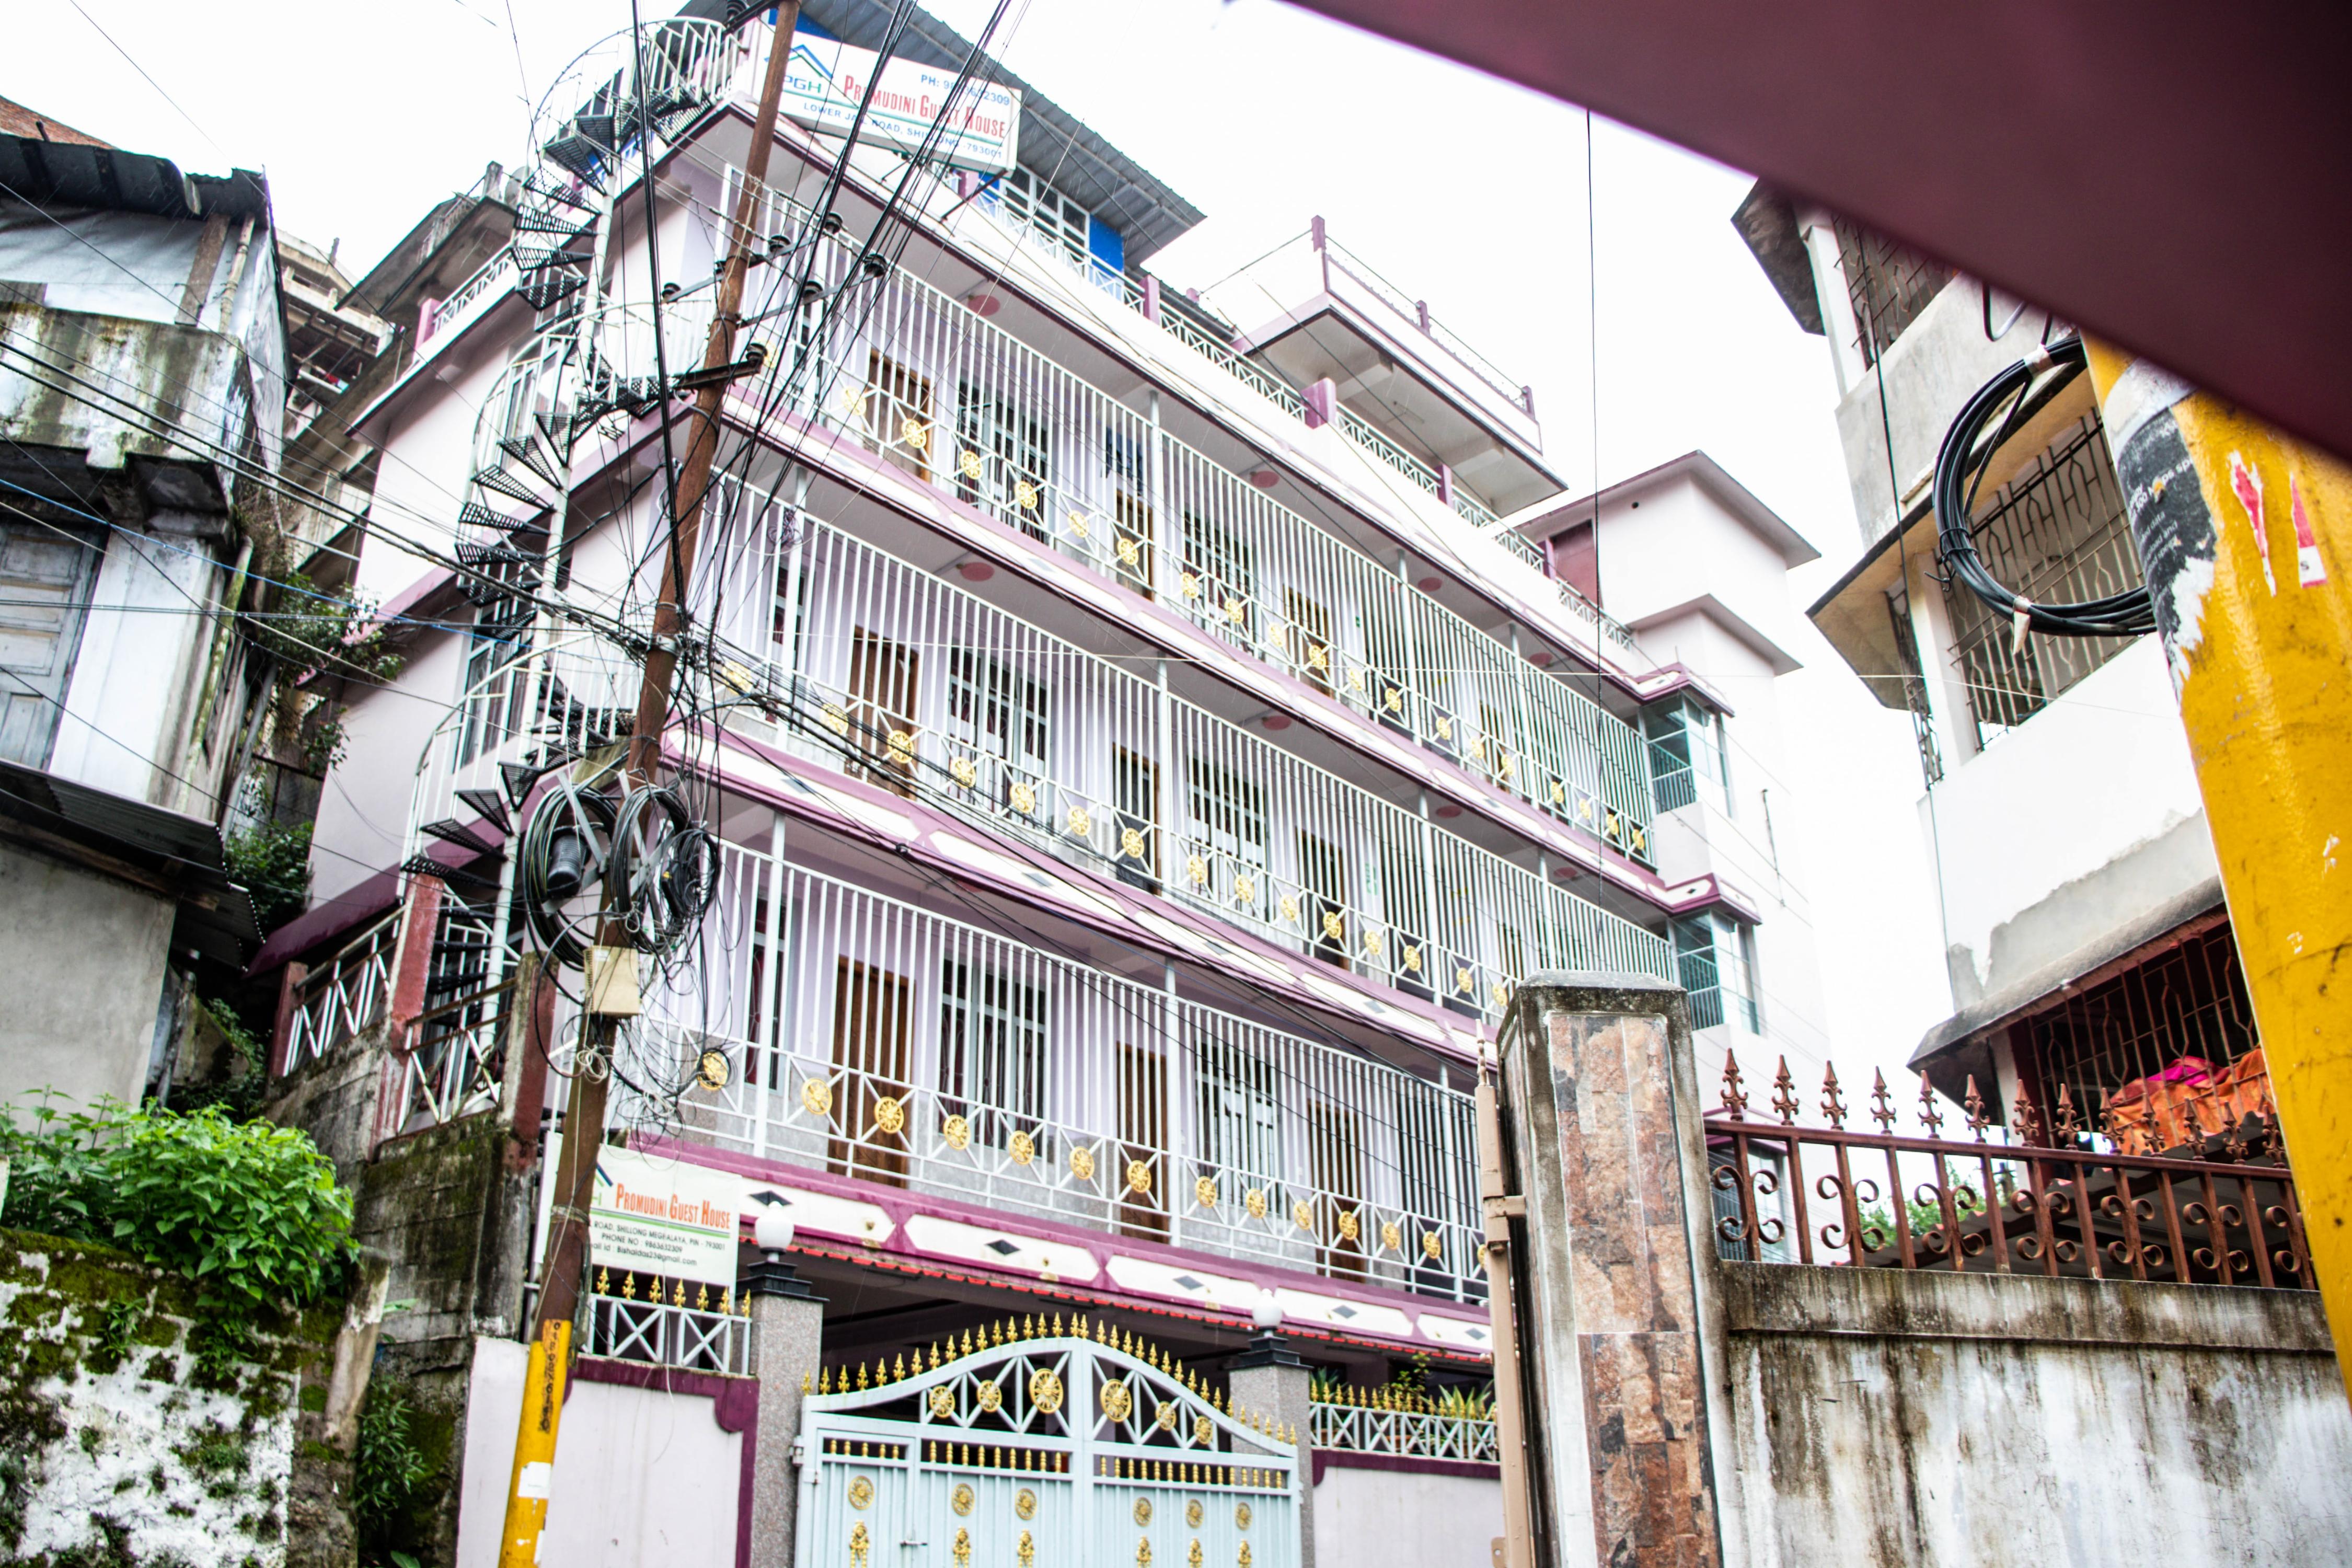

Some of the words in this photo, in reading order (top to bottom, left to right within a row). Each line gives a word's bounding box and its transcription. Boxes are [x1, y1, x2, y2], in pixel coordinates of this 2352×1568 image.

[921, 75, 939, 87] PH:
[844, 75, 916, 114] PRMUDINI
[804, 102, 841, 118] LOWER
[616, 1182, 667, 1217] PROMUDINI
[670, 1193, 699, 1224] GUEST
[701, 1199, 731, 1229] HOUSE
[602, 1232, 626, 1243] PHONE
[617, 1225, 647, 1237] SHILLONG
[690, 1237, 699, 1246] PIN
